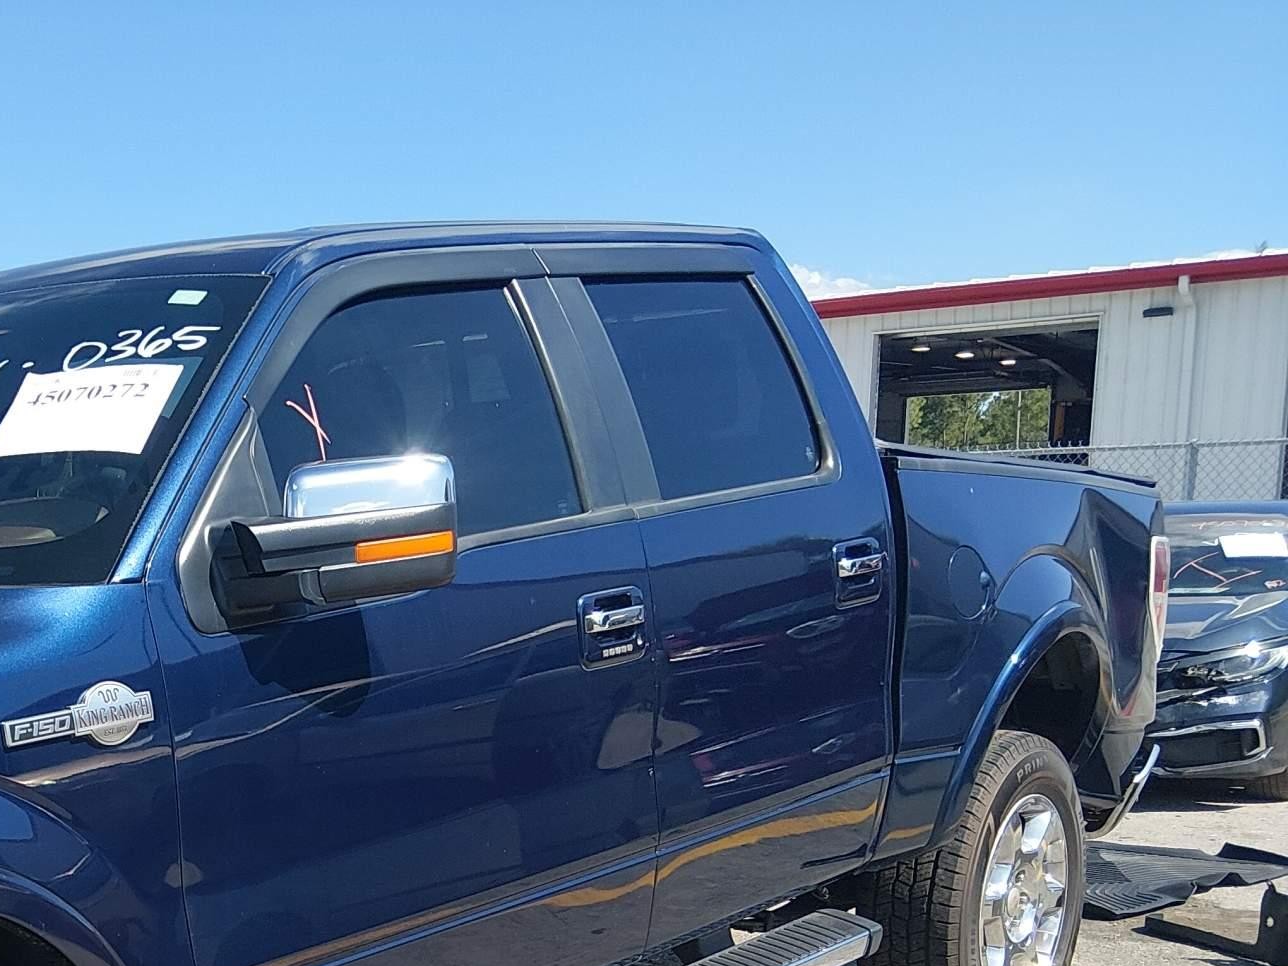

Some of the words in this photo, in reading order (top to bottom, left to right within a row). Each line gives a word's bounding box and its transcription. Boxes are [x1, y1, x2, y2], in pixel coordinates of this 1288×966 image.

[63, 325, 221, 373] 0365
[26, 383, 150, 408] 45070272
[76, 708, 108, 729] KING
[111, 697, 151, 723] RANCH
[14, 715, 71, 740] F-150
